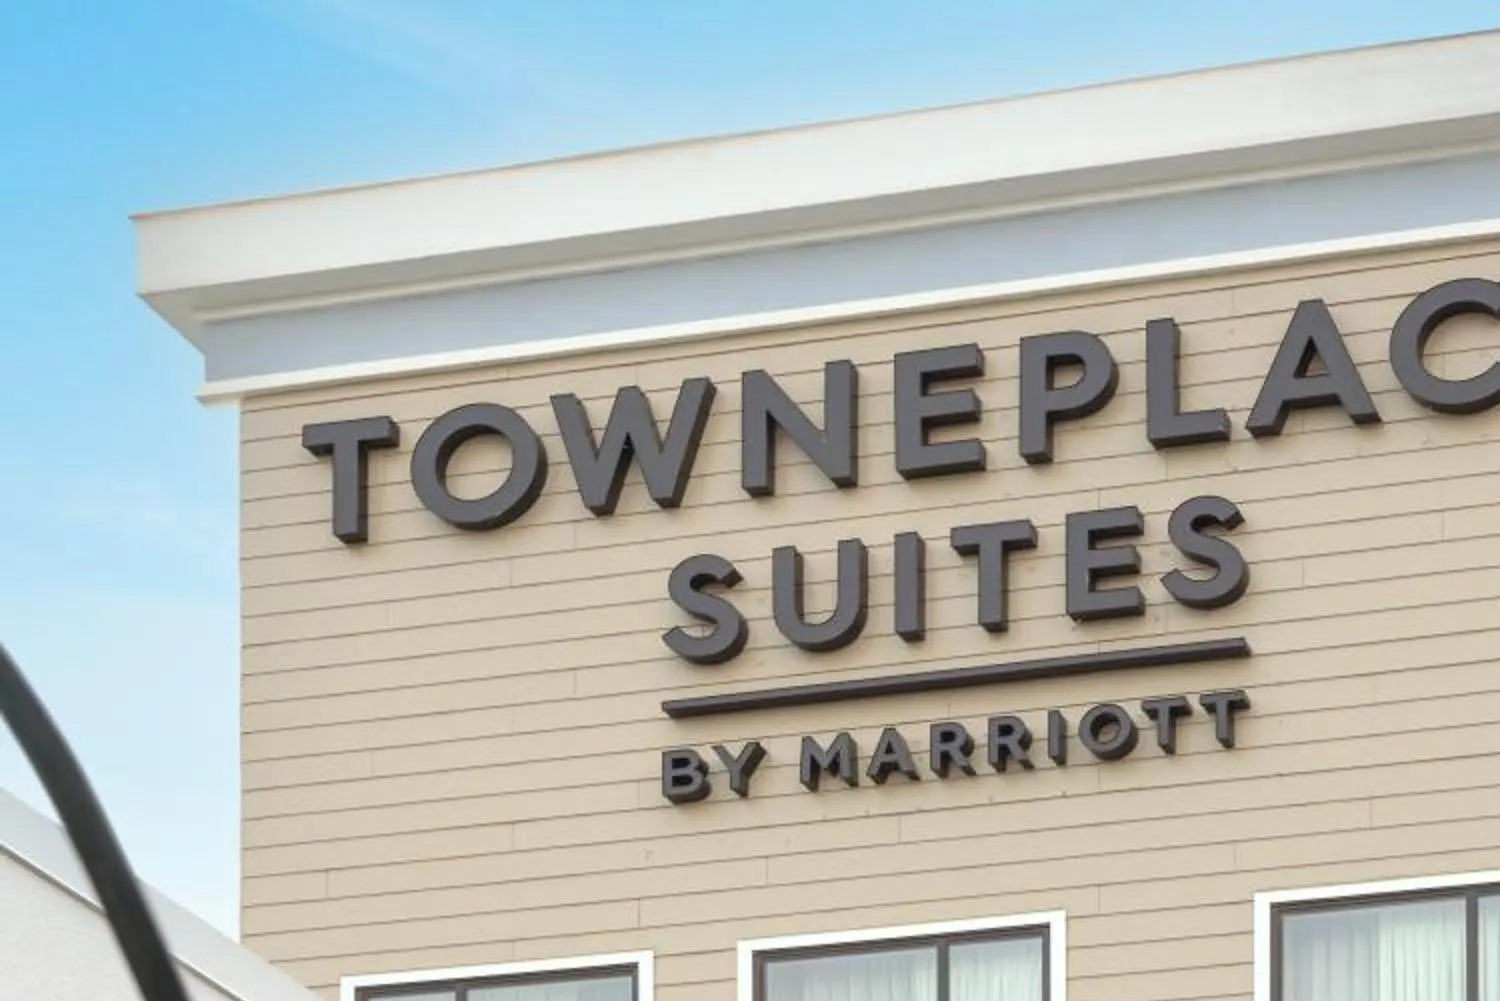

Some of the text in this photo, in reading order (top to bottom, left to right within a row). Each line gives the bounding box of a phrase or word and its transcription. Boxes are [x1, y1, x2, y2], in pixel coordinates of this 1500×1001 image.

[662, 495, 1248, 666] SUITES
[662, 690, 1251, 805] BY MARRIOTT
